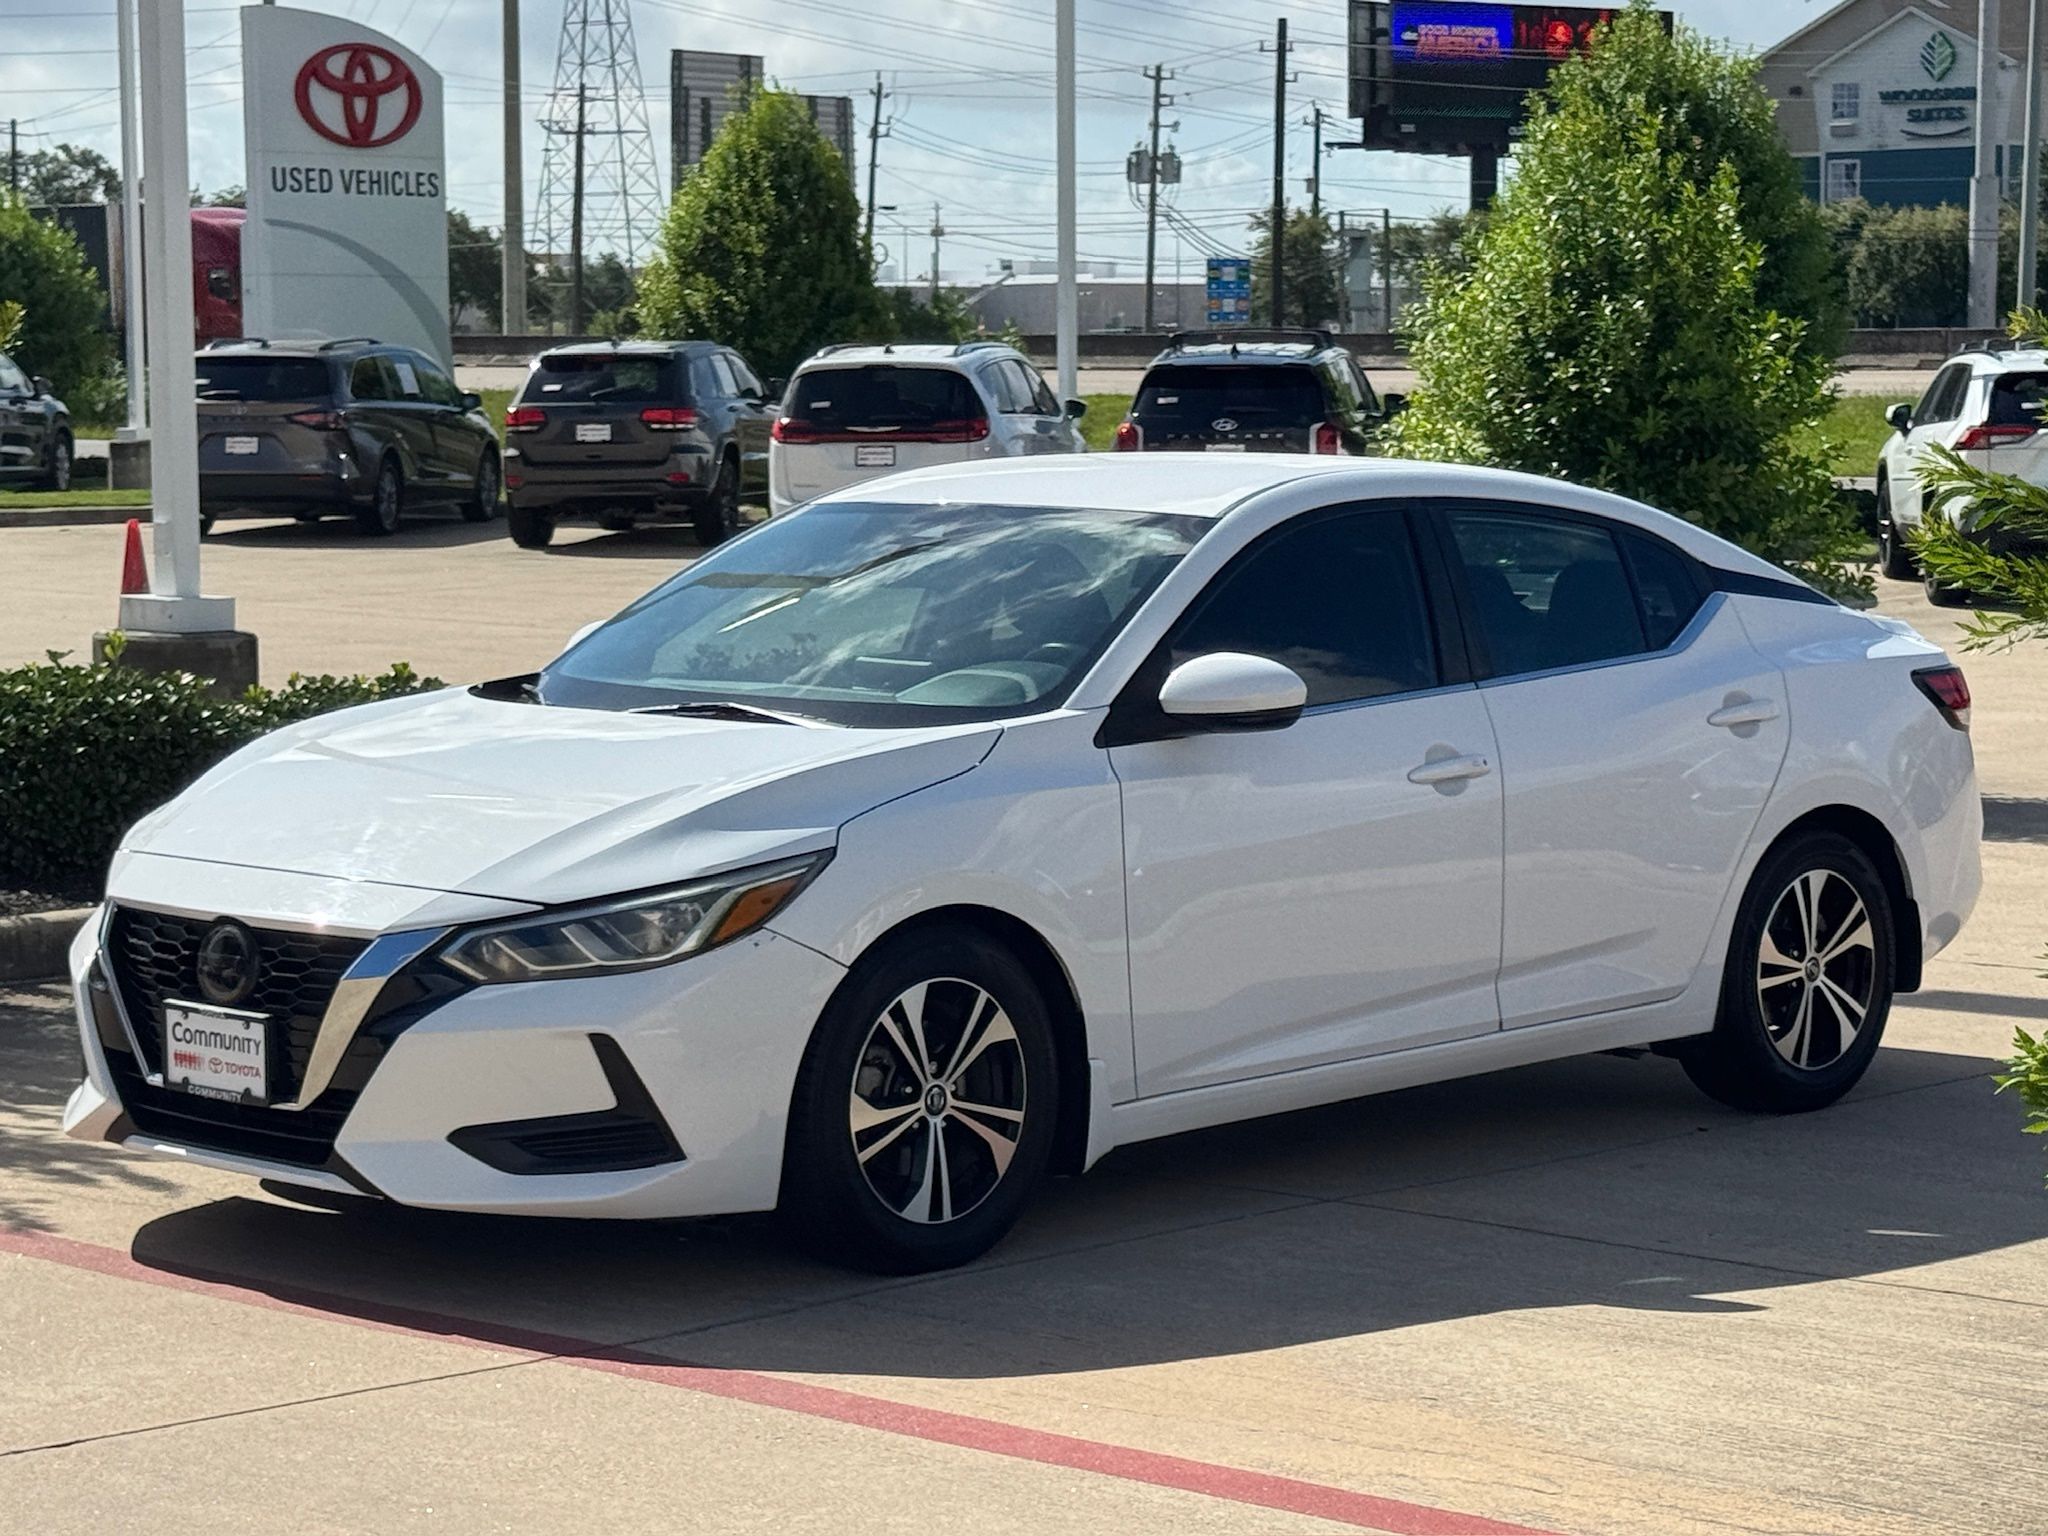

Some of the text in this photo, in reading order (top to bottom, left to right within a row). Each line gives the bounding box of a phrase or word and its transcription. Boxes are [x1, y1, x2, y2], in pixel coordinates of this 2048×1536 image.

[272, 166, 439, 198] USED VEHICLES
[225, 1061, 261, 1078] TOYOTA
